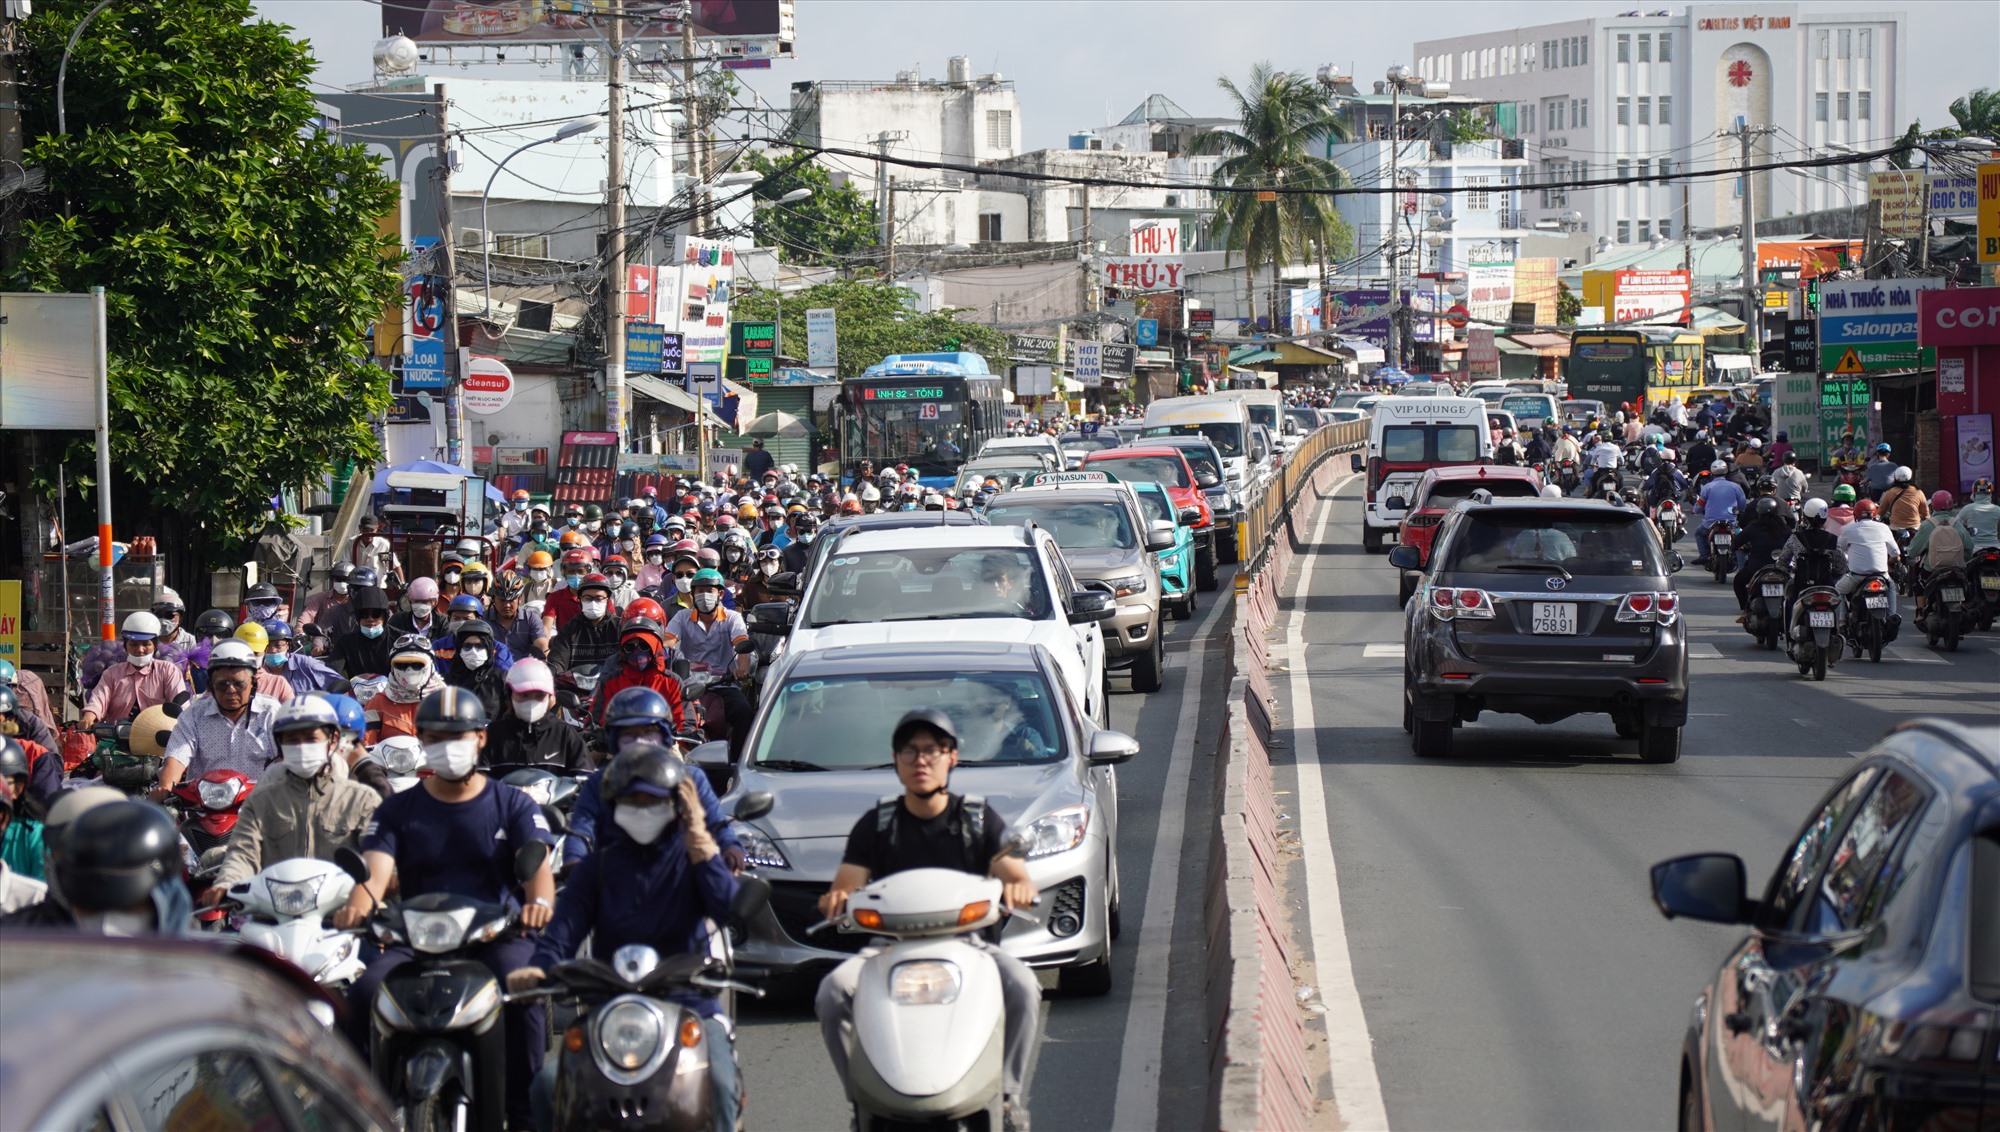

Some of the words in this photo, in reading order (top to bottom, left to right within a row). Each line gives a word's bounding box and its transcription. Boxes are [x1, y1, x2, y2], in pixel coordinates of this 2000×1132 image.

[1698, 17, 1739, 30] CARITAS
[1743, 15, 1764, 31] VIỆT
[1768, 16, 1791, 29] NAM
[1826, 290, 1847, 309] NHÀ
[1852, 286, 1886, 307] THUỐC
[1890, 286, 1912, 305] HÒA
[745, 326, 774, 339] KARAOKE
[1795, 324, 1809, 335] NHÀ
[1080, 344, 1098, 354] HỚT
[1790, 338, 1814, 350] THUỐC
[414, 354, 436, 368] LOẠI
[663, 360, 676, 368] TÂY
[1080, 356, 1097, 366] TÓC
[1795, 354, 1809, 365] TÂY
[1076, 368, 1100, 376] NAM
[466, 378, 505, 388] Cleansui
[1786, 378, 1811, 392] NHÀ
[1824, 382, 1840, 392] NHÀ
[1842, 381, 1867, 391] TUỐC
[896, 390, 906, 398] S2
[915, 388, 934, 397] TÔN
[1846, 392, 1869, 404] ÌNH
[922, 405, 936, 418] 19
[1395, 406, 1413, 414] VIP
[1416, 406, 1466, 414] LOUNGE
[1789, 422, 1811, 438] TÂY
[1050, 474, 1087, 482] VINASUN
[1544, 605, 1565, 618] 51A
[1535, 619, 1572, 632] 758.91
